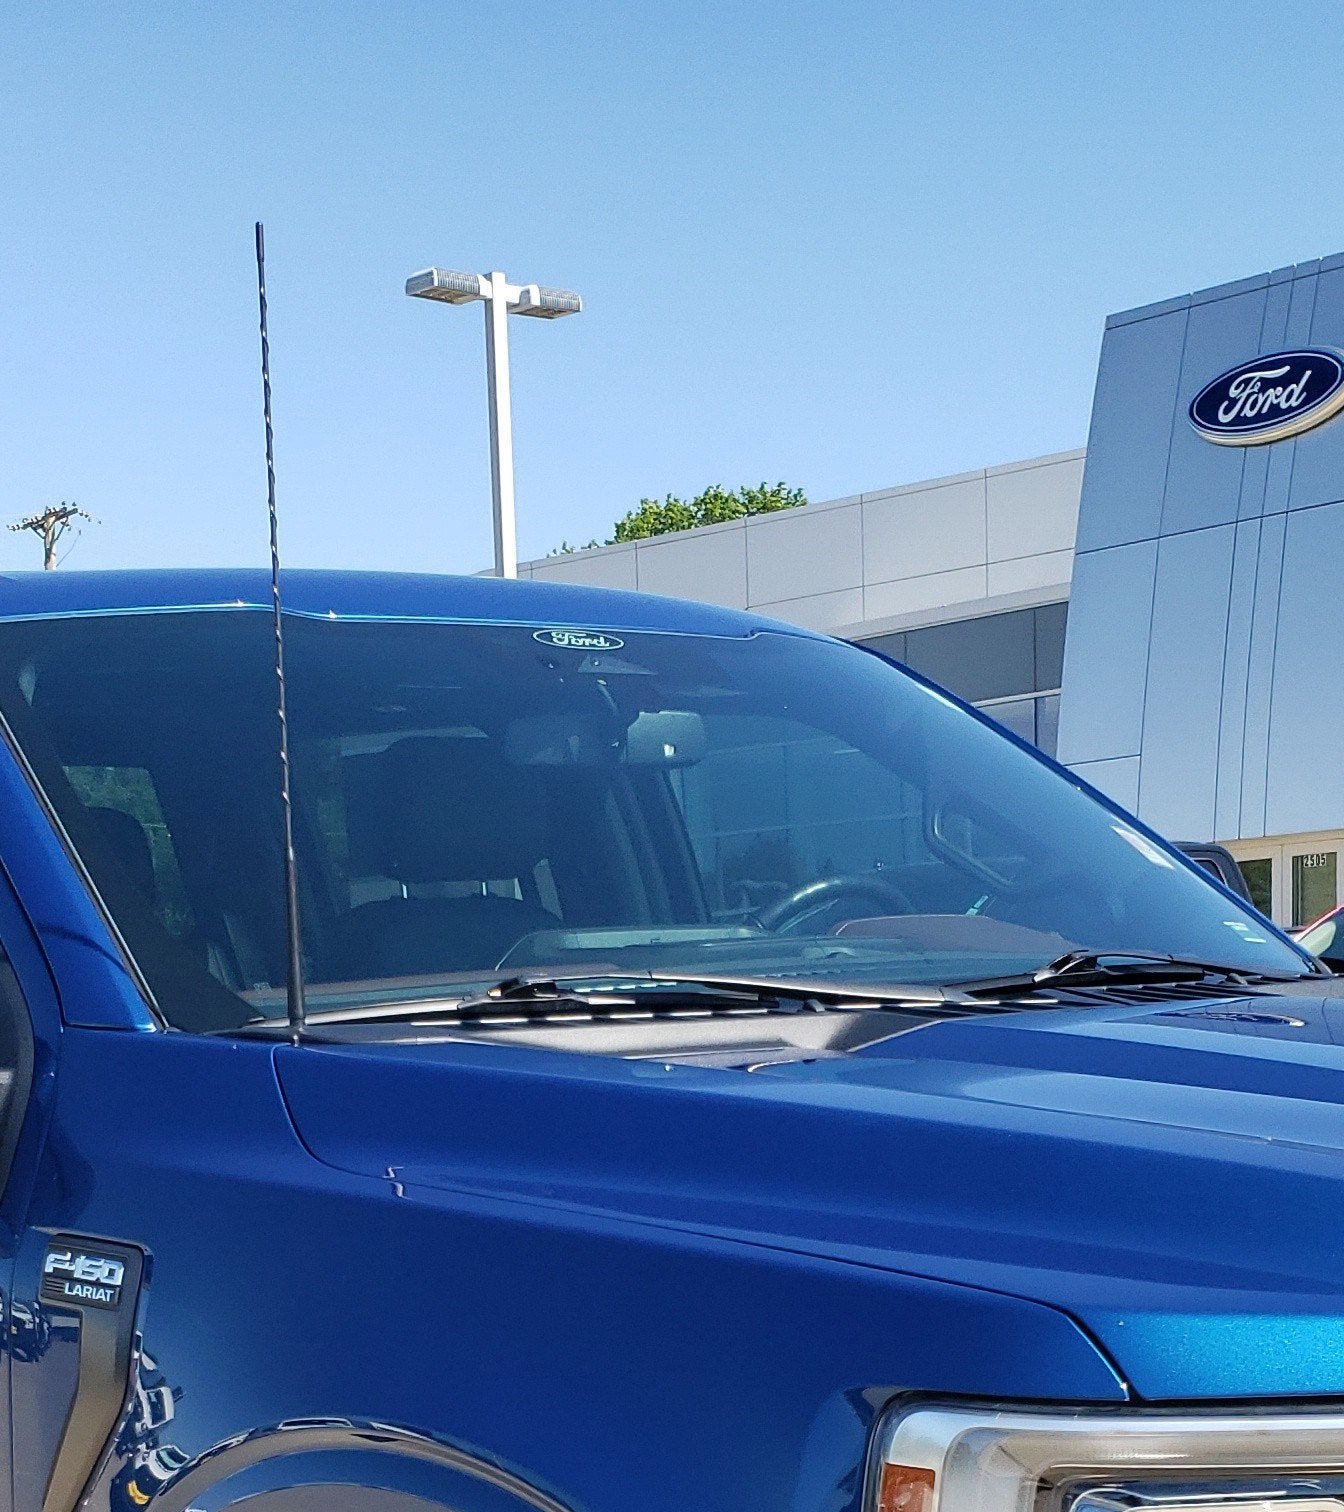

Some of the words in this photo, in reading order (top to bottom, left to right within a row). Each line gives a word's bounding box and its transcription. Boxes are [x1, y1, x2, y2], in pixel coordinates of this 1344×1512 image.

[1217, 365, 1313, 423] Ford
[550, 630, 611, 647] Ford
[1302, 853, 1327, 868] 2505
[44, 1252, 125, 1286] F-150
[64, 1282, 115, 1302] LARIAT
